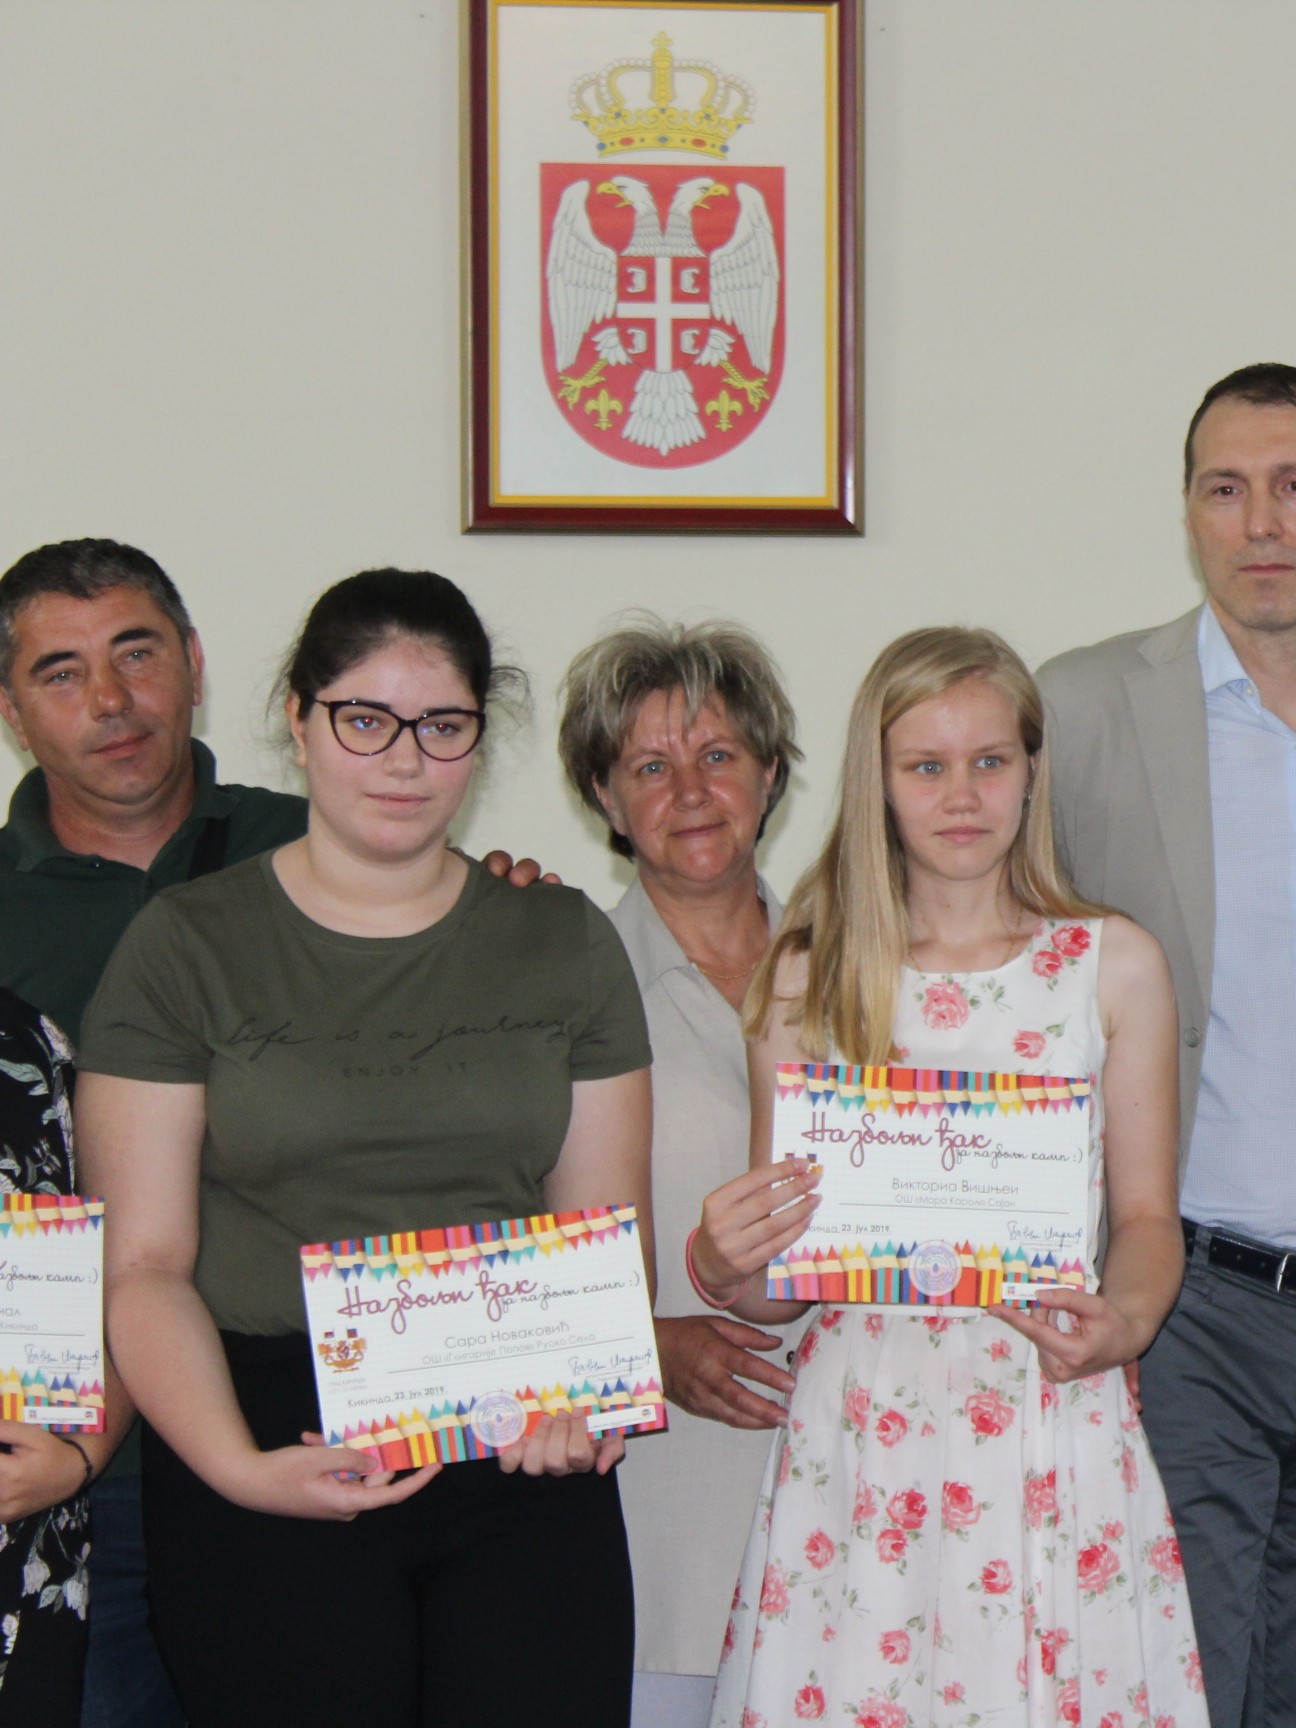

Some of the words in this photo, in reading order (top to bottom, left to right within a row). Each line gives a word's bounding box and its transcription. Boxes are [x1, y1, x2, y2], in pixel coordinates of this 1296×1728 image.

[411, 1016, 565, 1062] journey
[343, 1064, 419, 1078] ENJOY
[448, 1061, 467, 1073] IT
[445, 1333, 488, 1352] Сара
[490, 1321, 570, 1343] Новаковић
